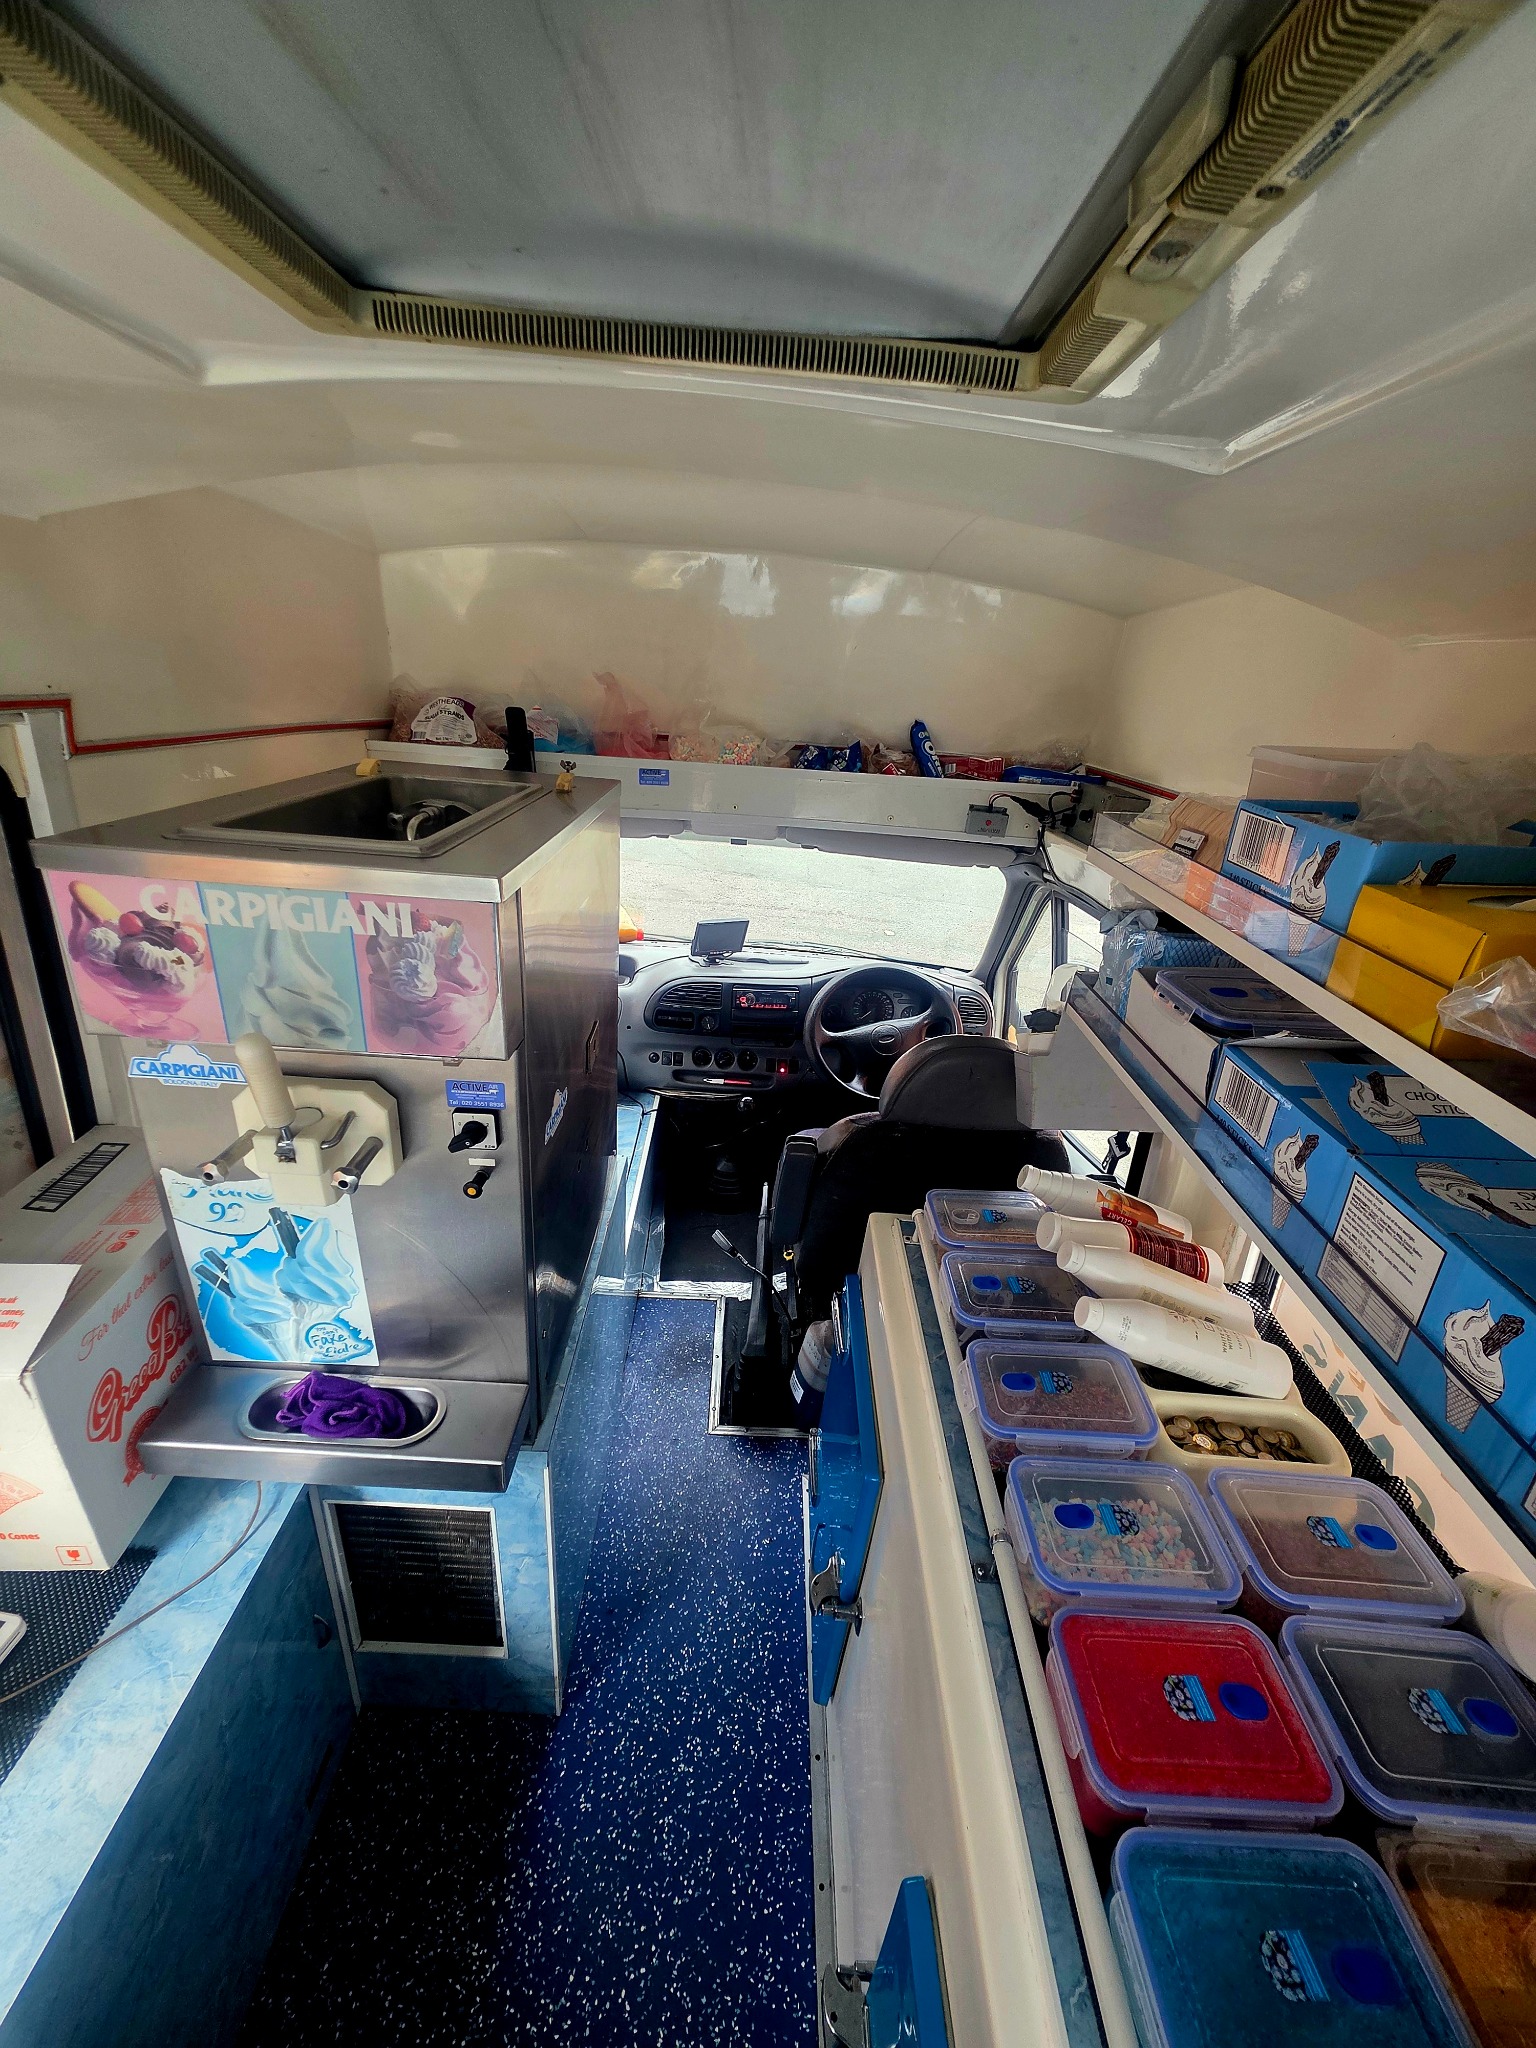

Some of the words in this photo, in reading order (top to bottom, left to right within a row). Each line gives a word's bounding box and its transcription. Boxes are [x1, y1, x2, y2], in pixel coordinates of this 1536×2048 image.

[439, 709, 465, 721] STRANDS
[138, 884, 415, 939] CARPIGIANI
[135, 1060, 239, 1080] CARPIGIANI
[452, 1081, 489, 1092] ACTIVE
[8, 1532, 41, 1540] Cones
